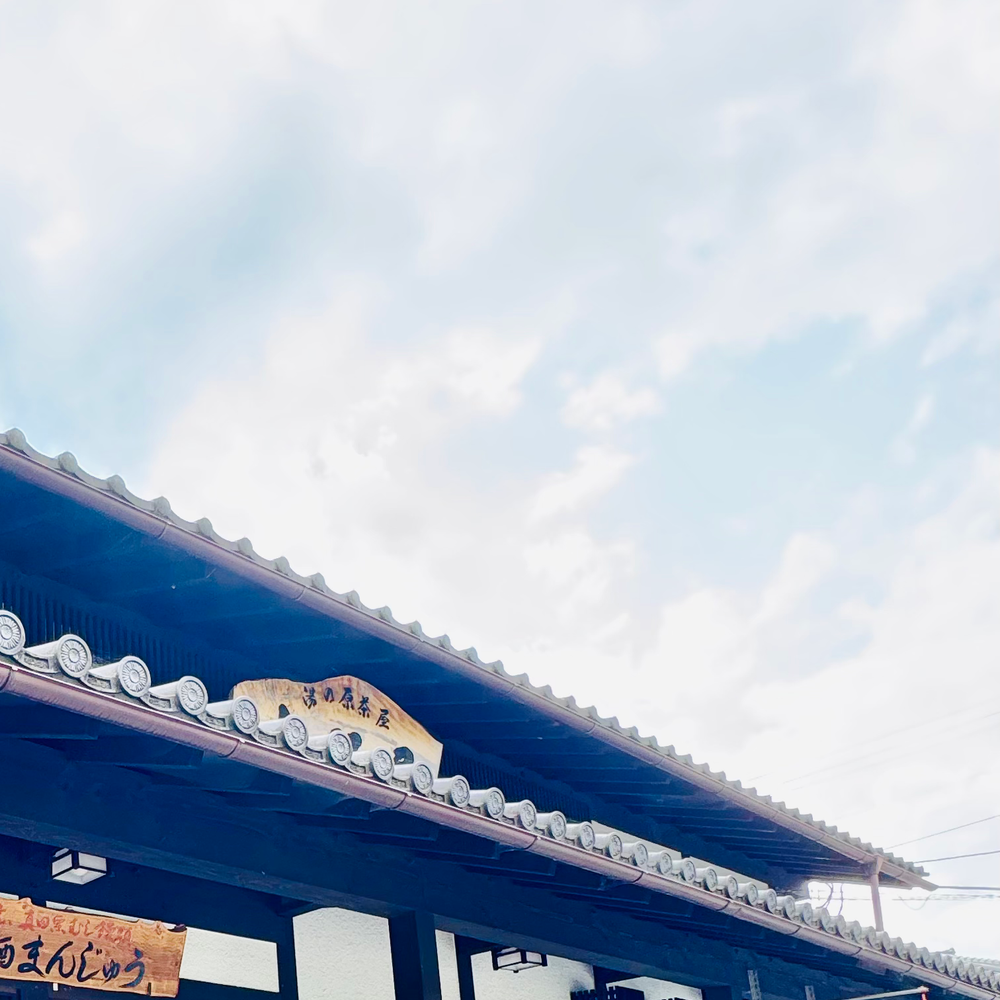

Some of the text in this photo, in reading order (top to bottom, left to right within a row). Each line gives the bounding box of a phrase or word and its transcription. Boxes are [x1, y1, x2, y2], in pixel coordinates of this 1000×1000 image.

[302, 685, 390, 730] 湯の原茶屋
